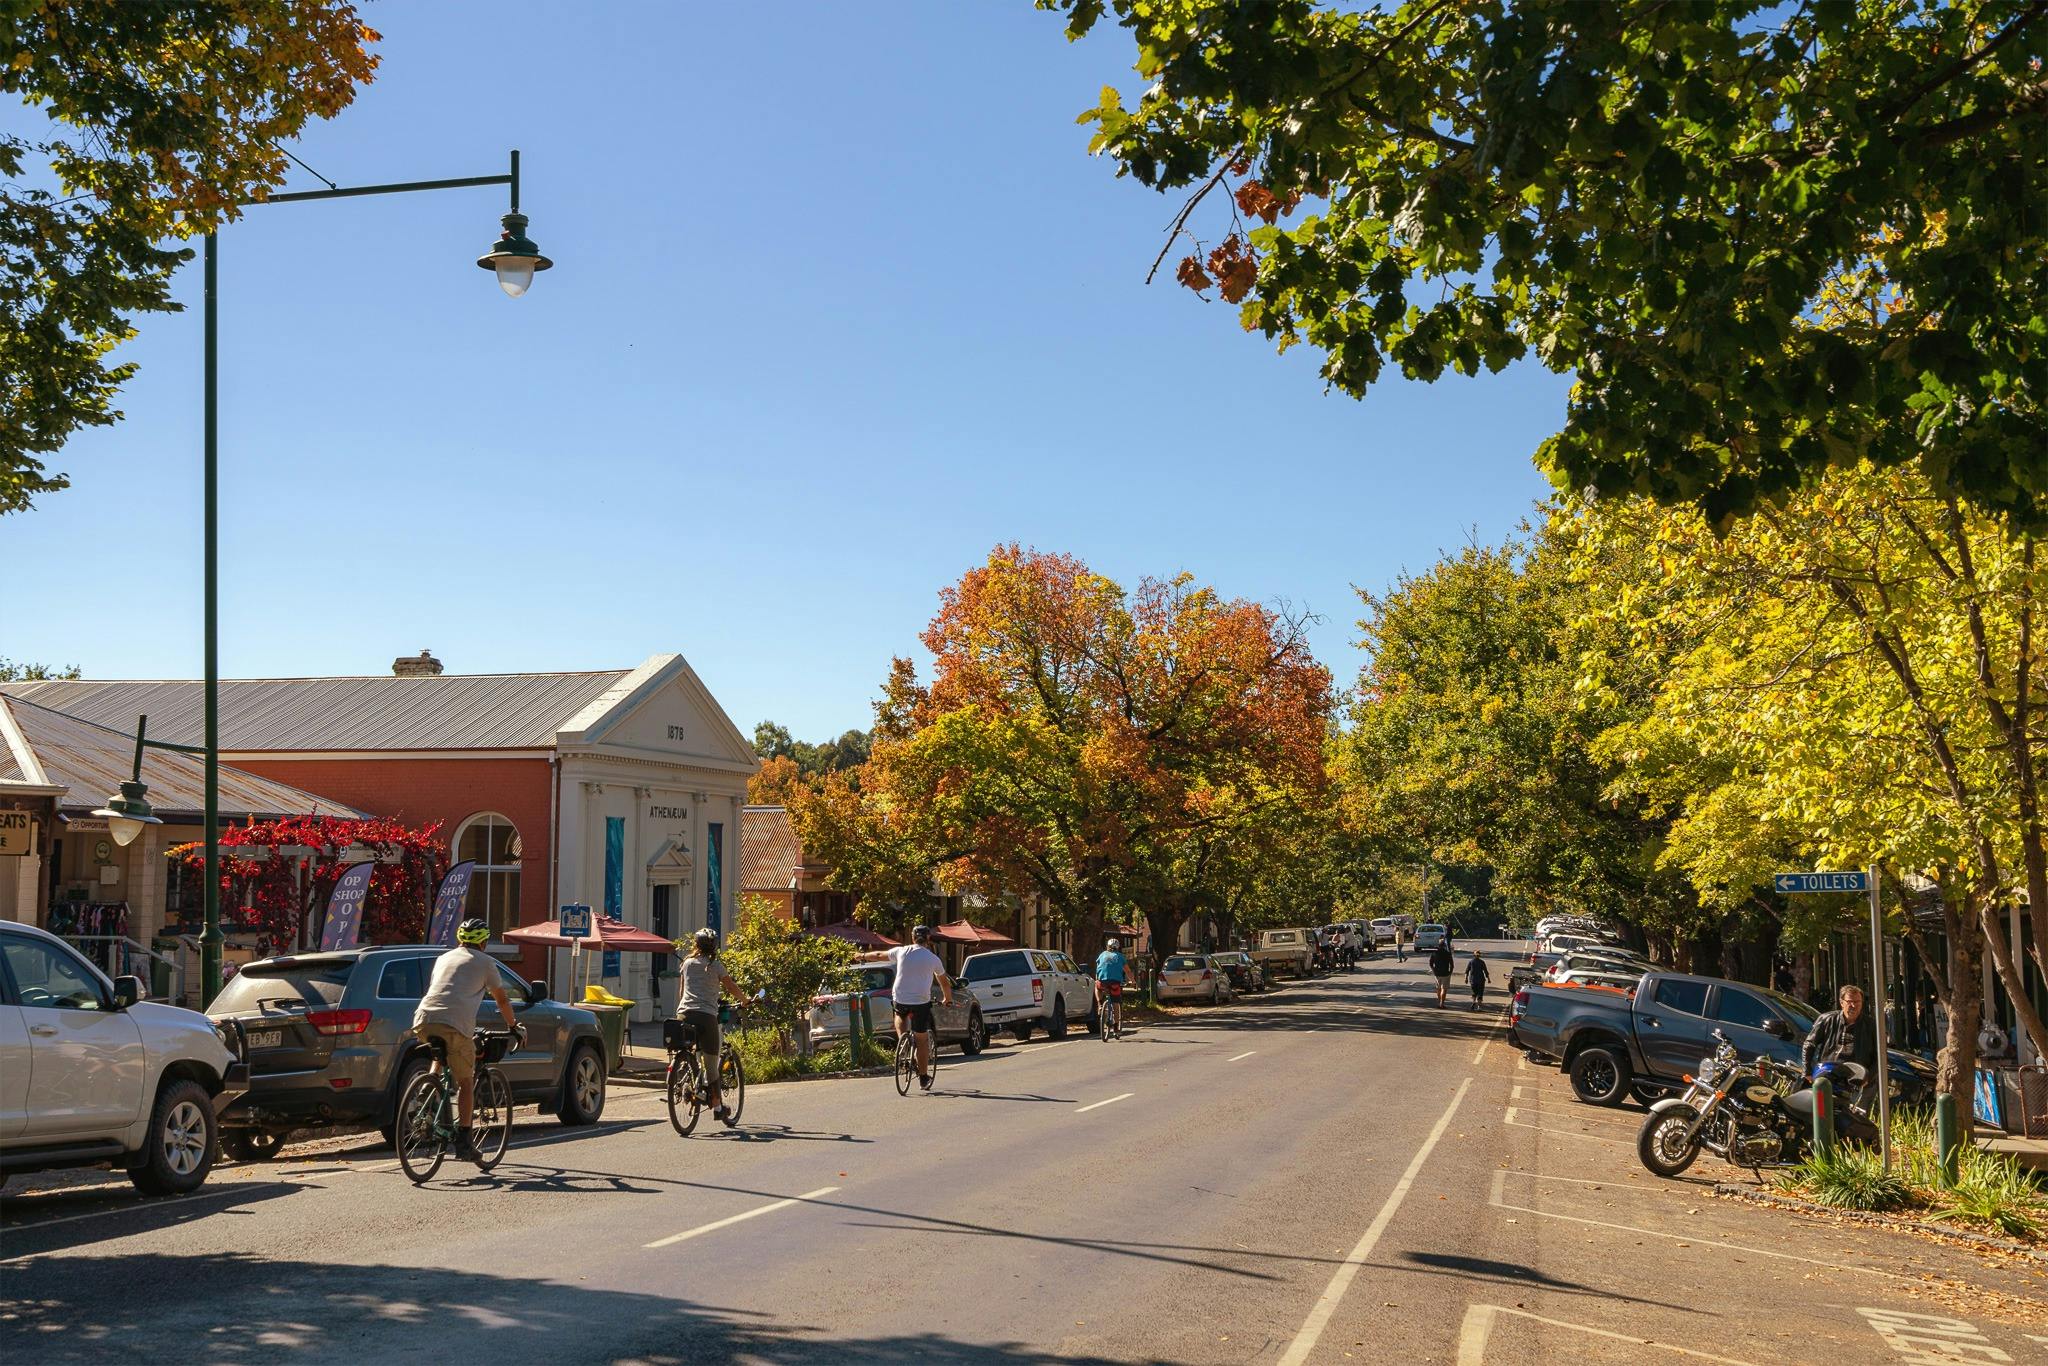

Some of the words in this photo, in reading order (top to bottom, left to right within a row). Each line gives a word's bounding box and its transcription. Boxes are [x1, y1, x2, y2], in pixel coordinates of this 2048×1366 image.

[667, 724, 684, 741] 1878
[649, 805, 687, 820] ATHENÆUM
[344, 876, 361, 887] OP
[449, 873, 464, 884] OP
[1801, 874, 1858, 889] TOILETS
[334, 889, 364, 901] SHOP
[440, 885, 467, 898] SHOP
[334, 902, 353, 951] OPE
